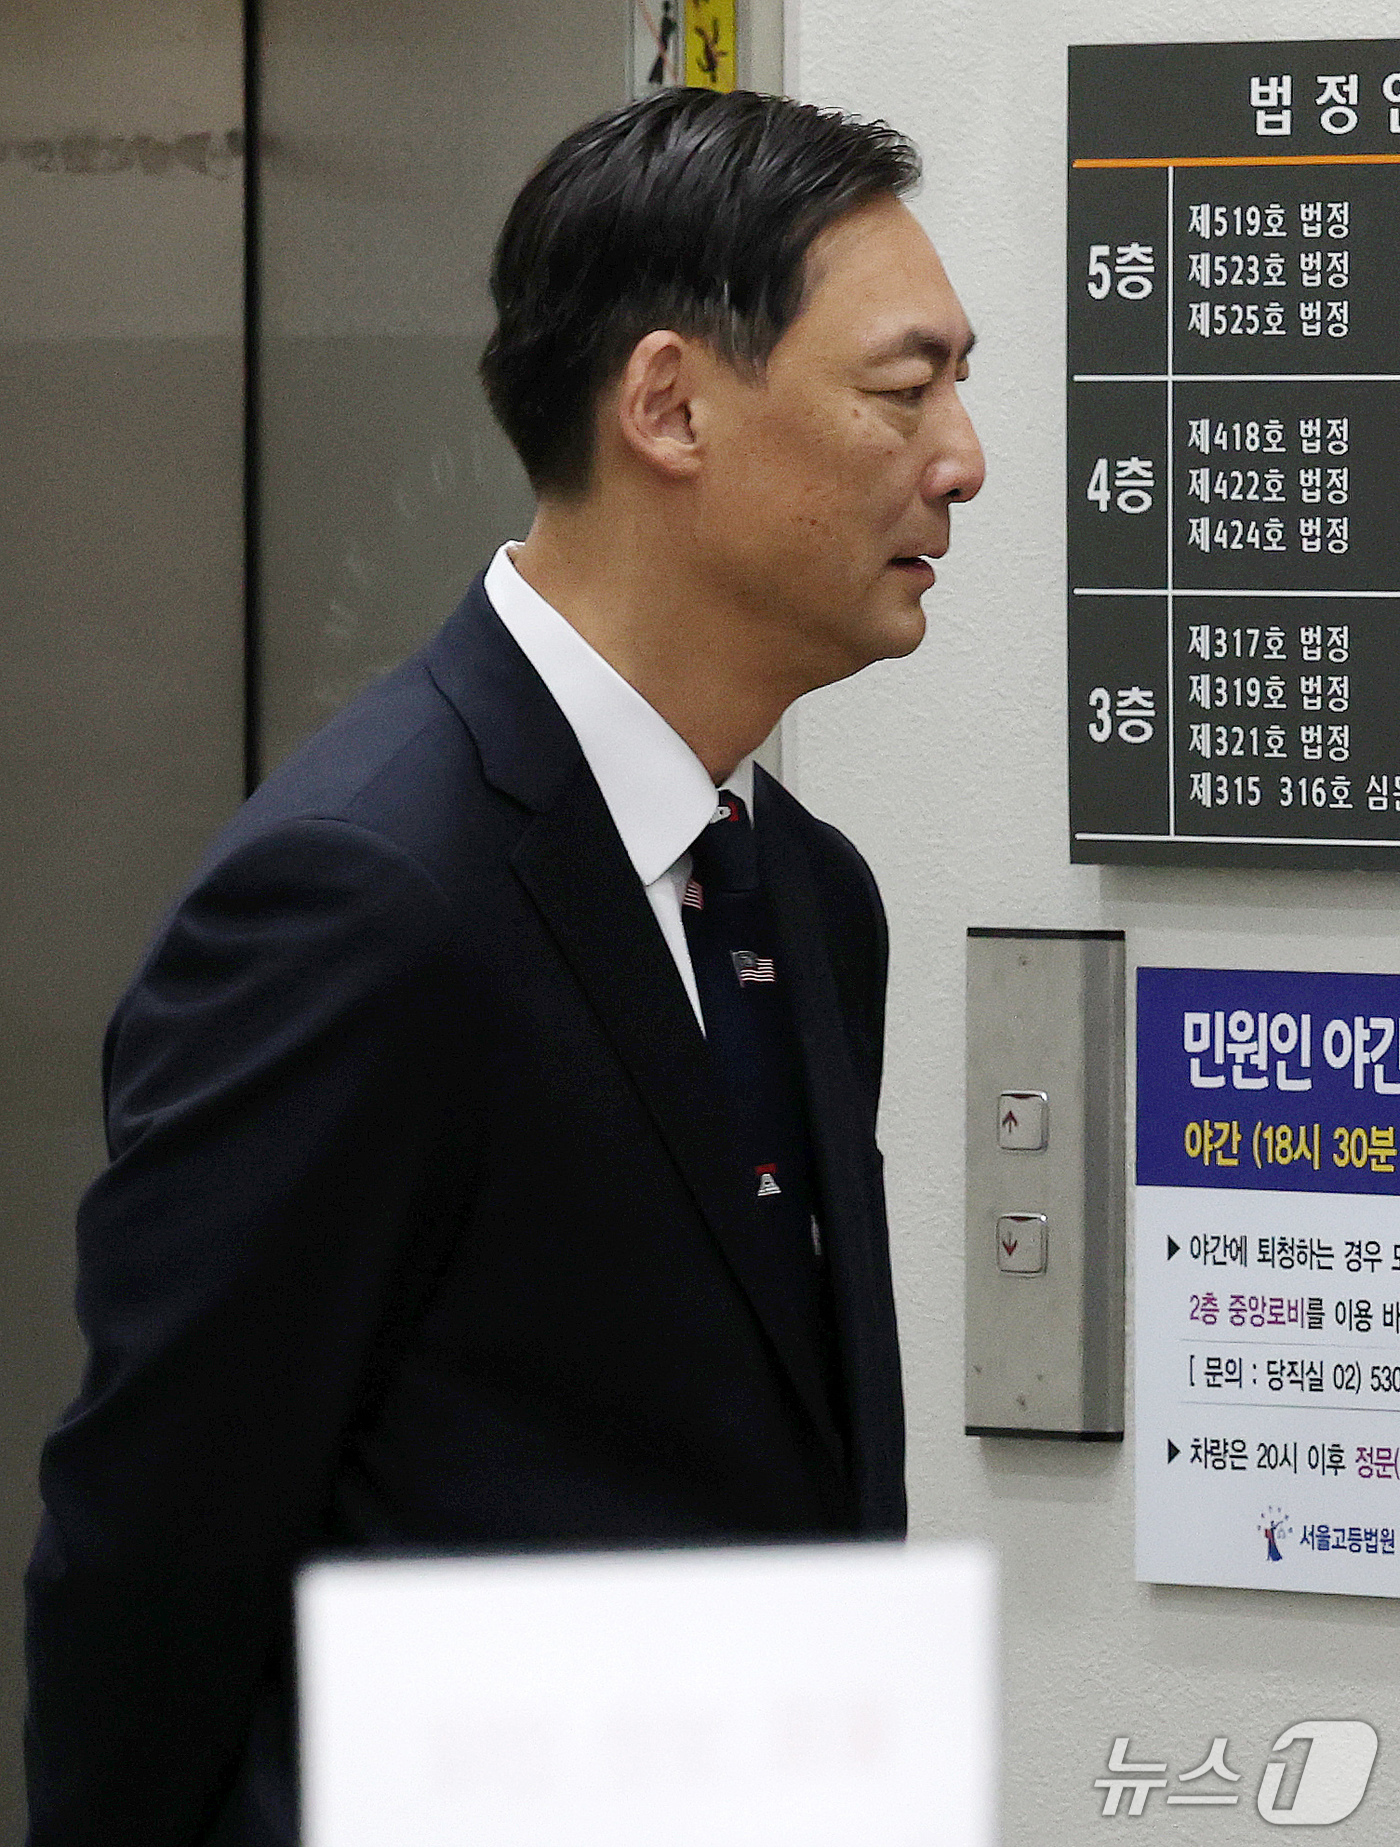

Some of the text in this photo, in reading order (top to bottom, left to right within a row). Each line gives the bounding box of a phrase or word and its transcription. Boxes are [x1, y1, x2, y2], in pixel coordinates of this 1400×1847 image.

[1189, 202, 1349, 240] 제519호 법정
[1088, 243, 1155, 300] 5층
[1189, 251, 1349, 289] 제523호 법정
[1188, 301, 1349, 338] 제525호 법정
[1189, 418, 1349, 455] 제418호 법정
[1088, 457, 1155, 514] 4층
[1188, 468, 1349, 505] 제422호 법정
[1189, 517, 1349, 554] 제424호 법정
[1189, 625, 1349, 663] 제317호 법정
[1189, 674, 1349, 712] 제319호 법정
[1089, 687, 1156, 744] 3층
[1189, 723, 1349, 762] 제321호 법정
[1190, 773, 1261, 808] 제315
[1281, 776, 1353, 809] 316호
[1185, 1011, 1312, 1091] 민원인
[1185, 1120, 1398, 1173] 야간 (18시 30분
[1190, 1234, 1248, 1268] 야간에
[1258, 1237, 1335, 1271] 퇴청하는
[1345, 1241, 1383, 1273] 경우
[1190, 1293, 1220, 1326] 2층
[1229, 1295, 1326, 1330] 중앙로비를
[1335, 1299, 1374, 1333] 이용
[1204, 1357, 1243, 1389] 문의
[1267, 1360, 1324, 1393] 당직실
[1334, 1362, 1362, 1395] 02)
[1191, 1438, 1249, 1471] 차량은
[1257, 1443, 1298, 1474] 20시
[1308, 1444, 1346, 1477] 이후
[1300, 1525, 1395, 1555] 서울고등법원
